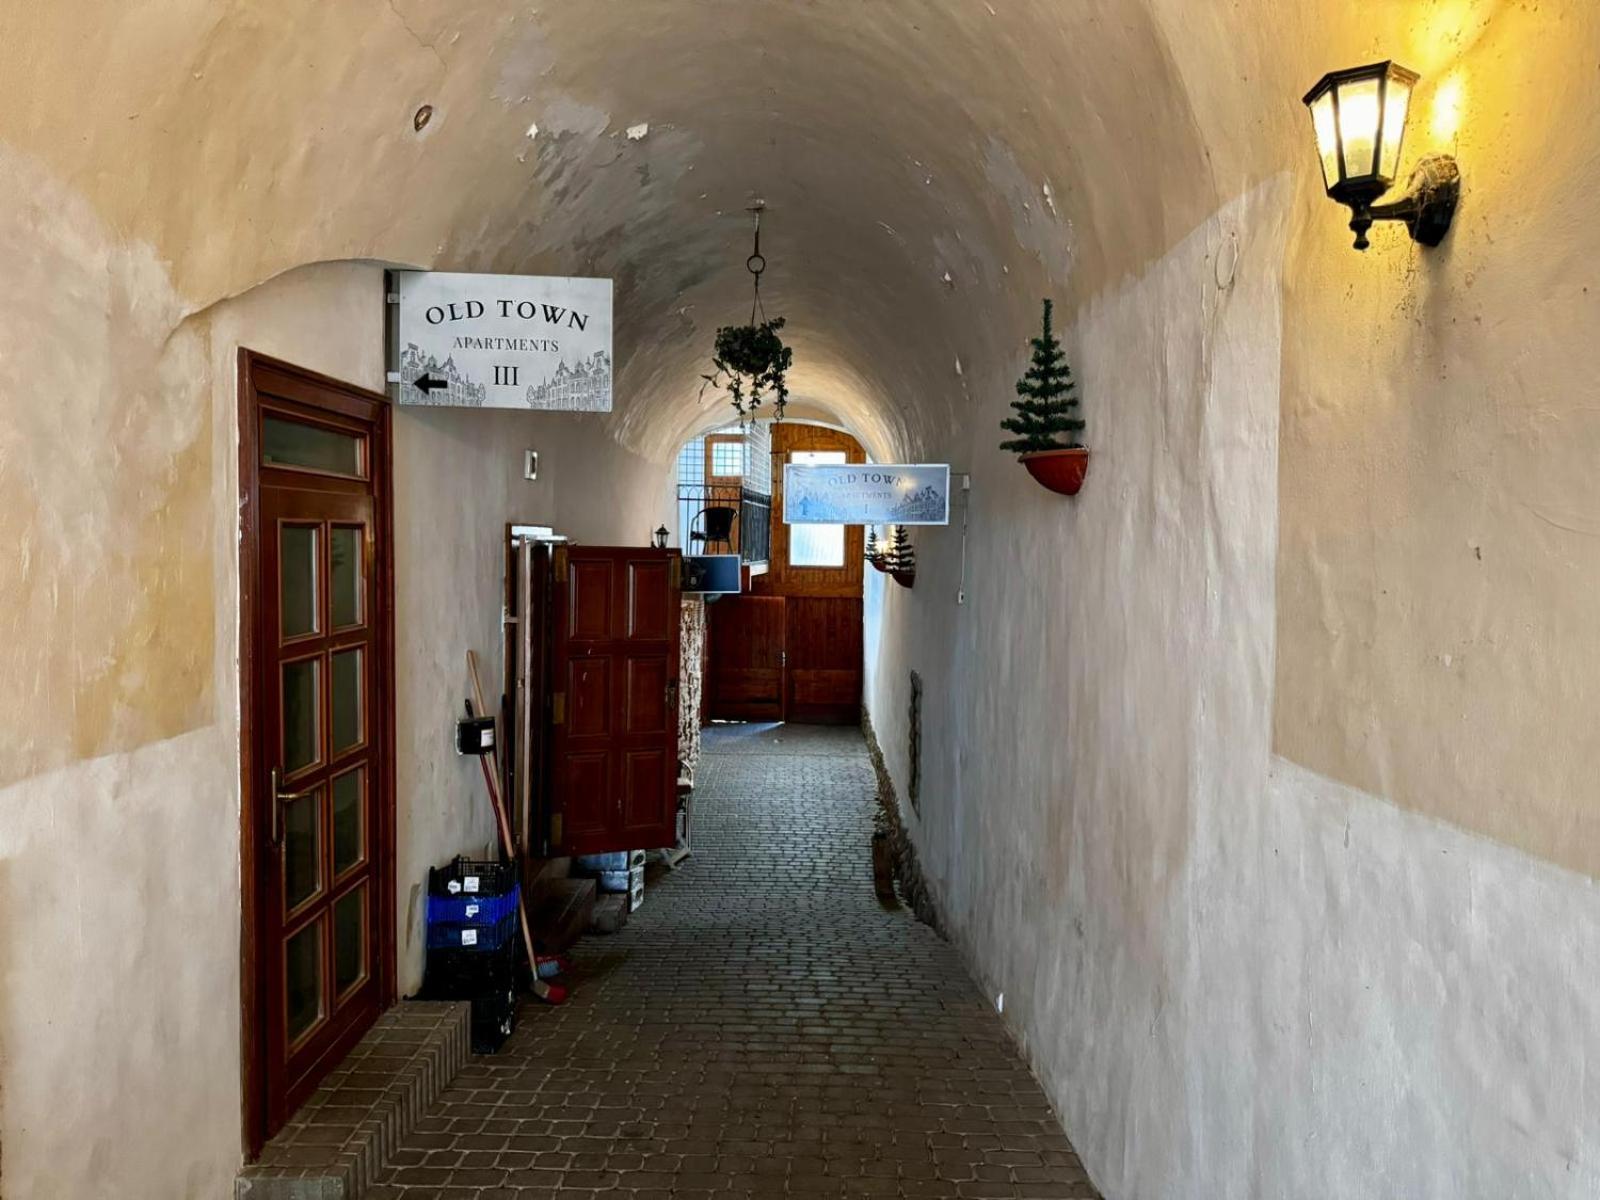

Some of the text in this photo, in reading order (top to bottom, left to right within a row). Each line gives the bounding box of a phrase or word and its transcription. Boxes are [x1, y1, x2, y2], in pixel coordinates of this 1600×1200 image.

[425, 299, 590, 332] OLD TOWN
[452, 337, 559, 352] APARTMENTS
[493, 365, 520, 386] III
[828, 473, 857, 487] OLD
